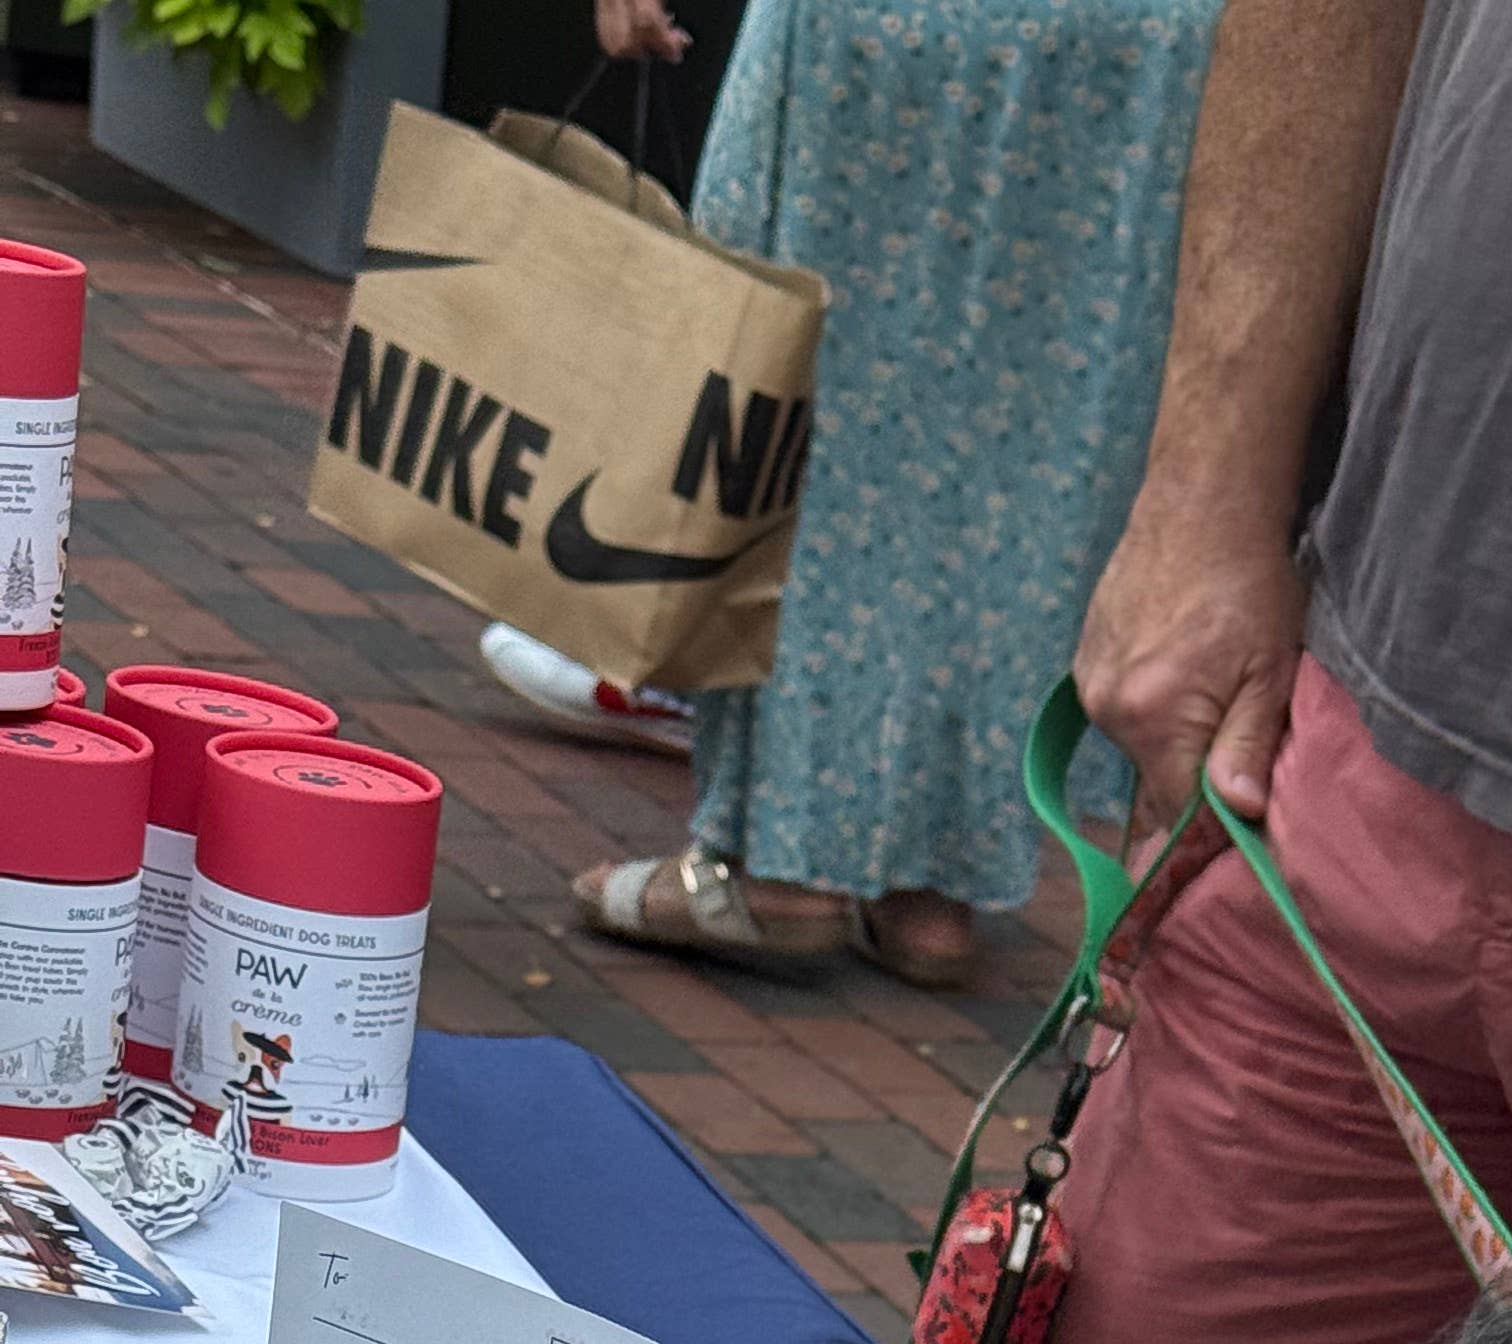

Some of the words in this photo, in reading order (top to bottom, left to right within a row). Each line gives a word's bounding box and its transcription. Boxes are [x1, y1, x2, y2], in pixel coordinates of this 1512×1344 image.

[328, 324, 553, 550] NIKE
[226, 909, 294, 941] INGREDIENT
[299, 928, 331, 946] DOG
[335, 934, 377, 949] TREATS
[235, 947, 309, 990] PAW
[299, 1134, 330, 1146] Liver
[318, 1250, 349, 1288] To
